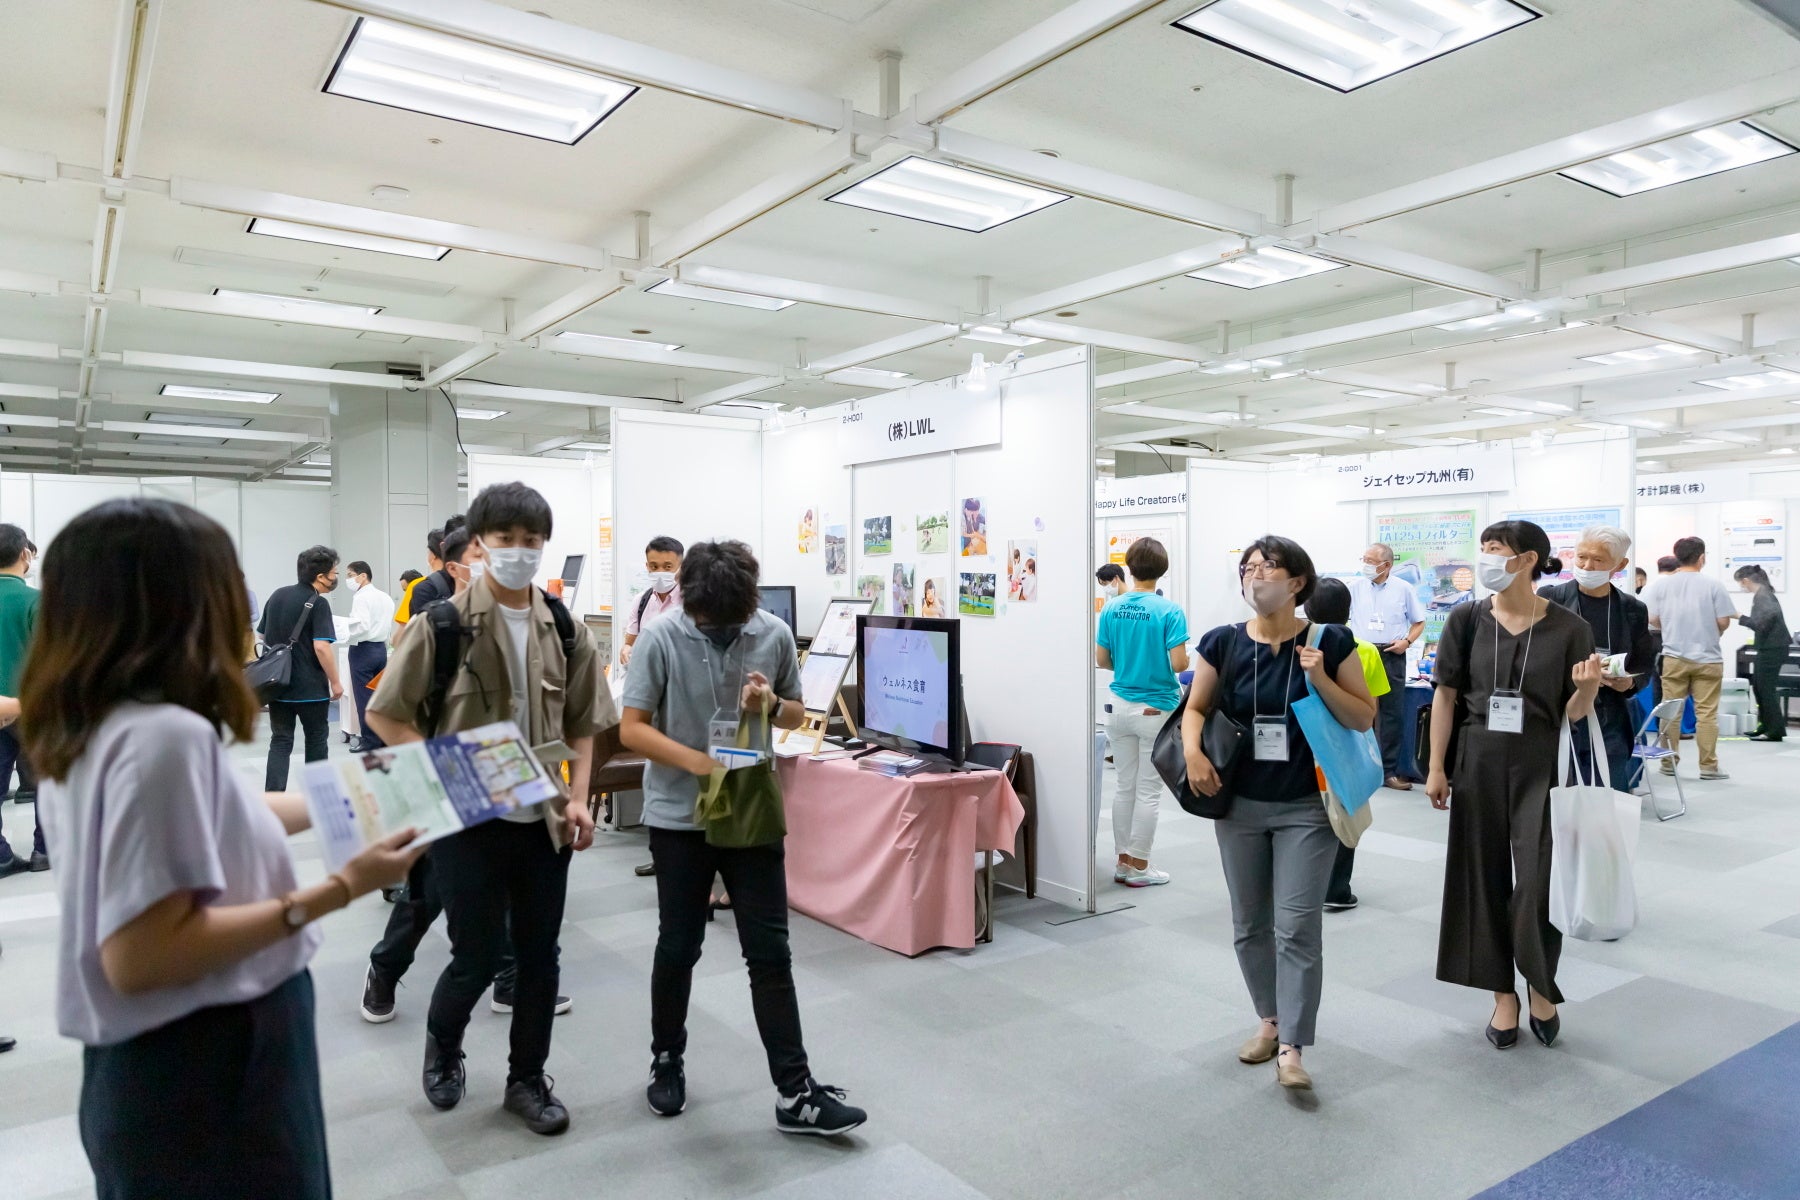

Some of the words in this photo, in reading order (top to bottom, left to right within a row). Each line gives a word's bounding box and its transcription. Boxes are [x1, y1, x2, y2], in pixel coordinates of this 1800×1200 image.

[888, 417, 935, 442] (株)LWL
[1363, 467, 1474, 488] ジェイセップ九州(有)
[1119, 497, 1135, 507] Life
[882, 675, 926, 694] ウェルネス食育
[1257, 729, 1264, 737] A
